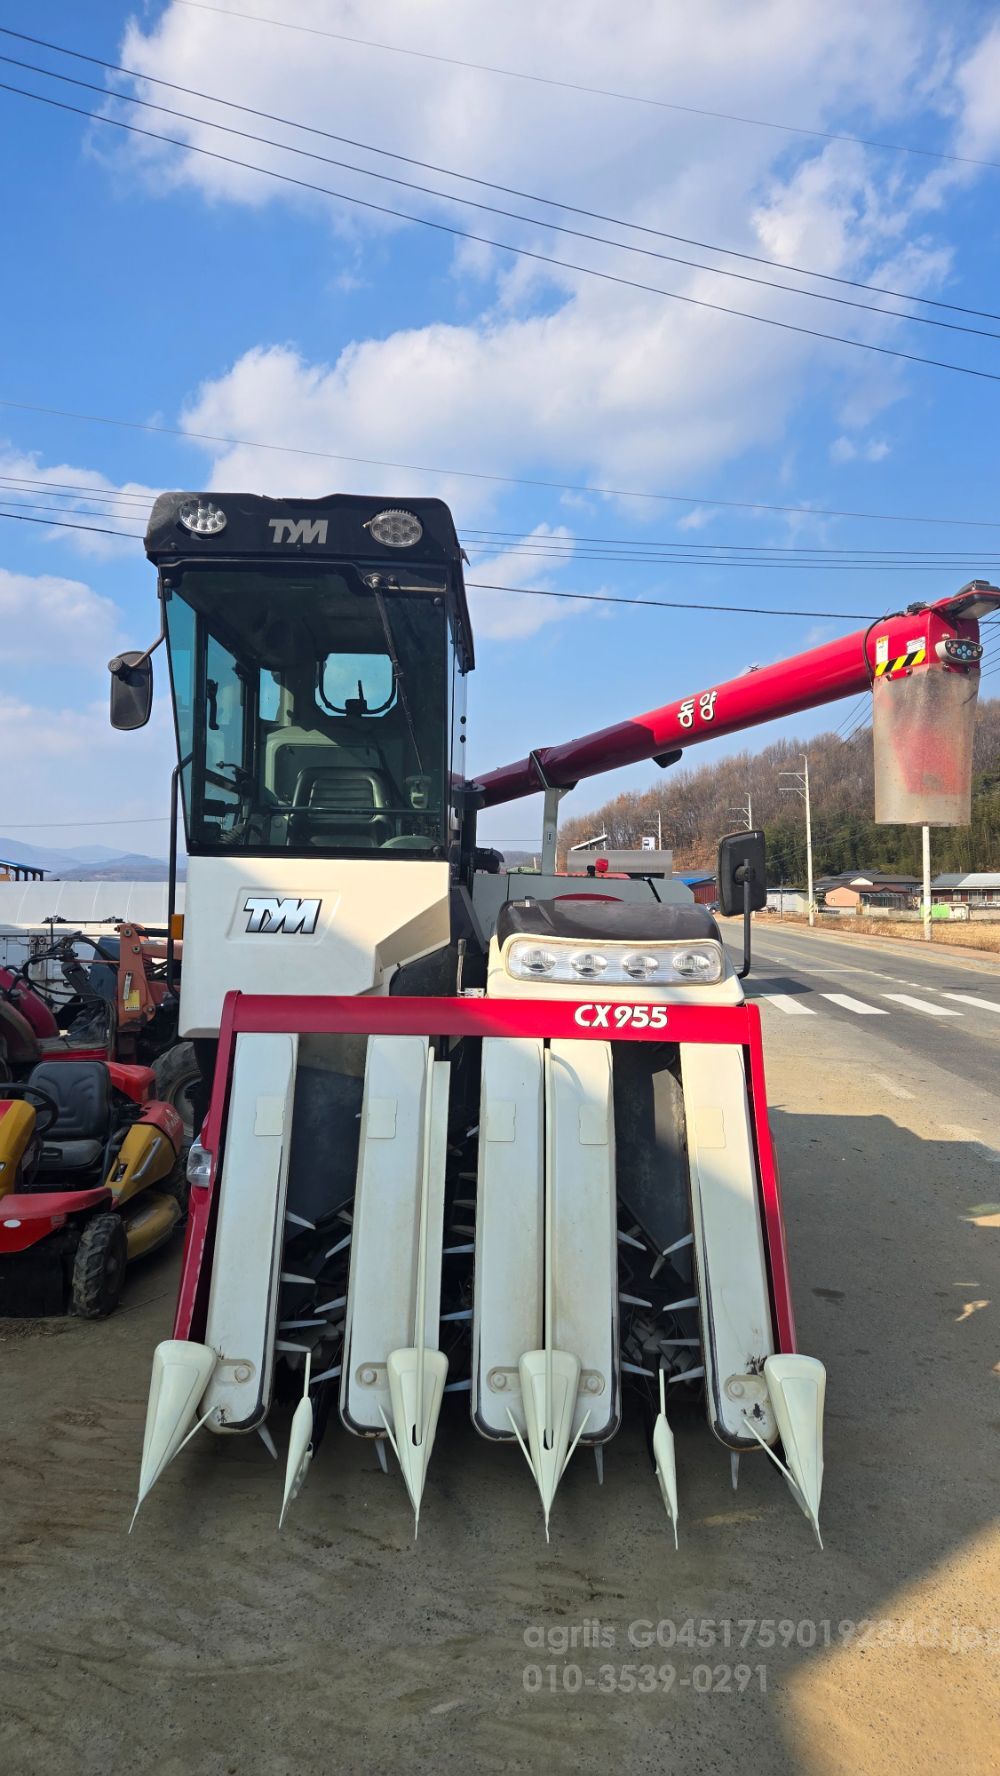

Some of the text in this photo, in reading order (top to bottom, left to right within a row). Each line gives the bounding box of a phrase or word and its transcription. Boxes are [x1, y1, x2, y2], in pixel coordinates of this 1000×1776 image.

[268, 519, 329, 544] TYM
[677, 690, 718, 728] 동양
[243, 897, 322, 934] TYM
